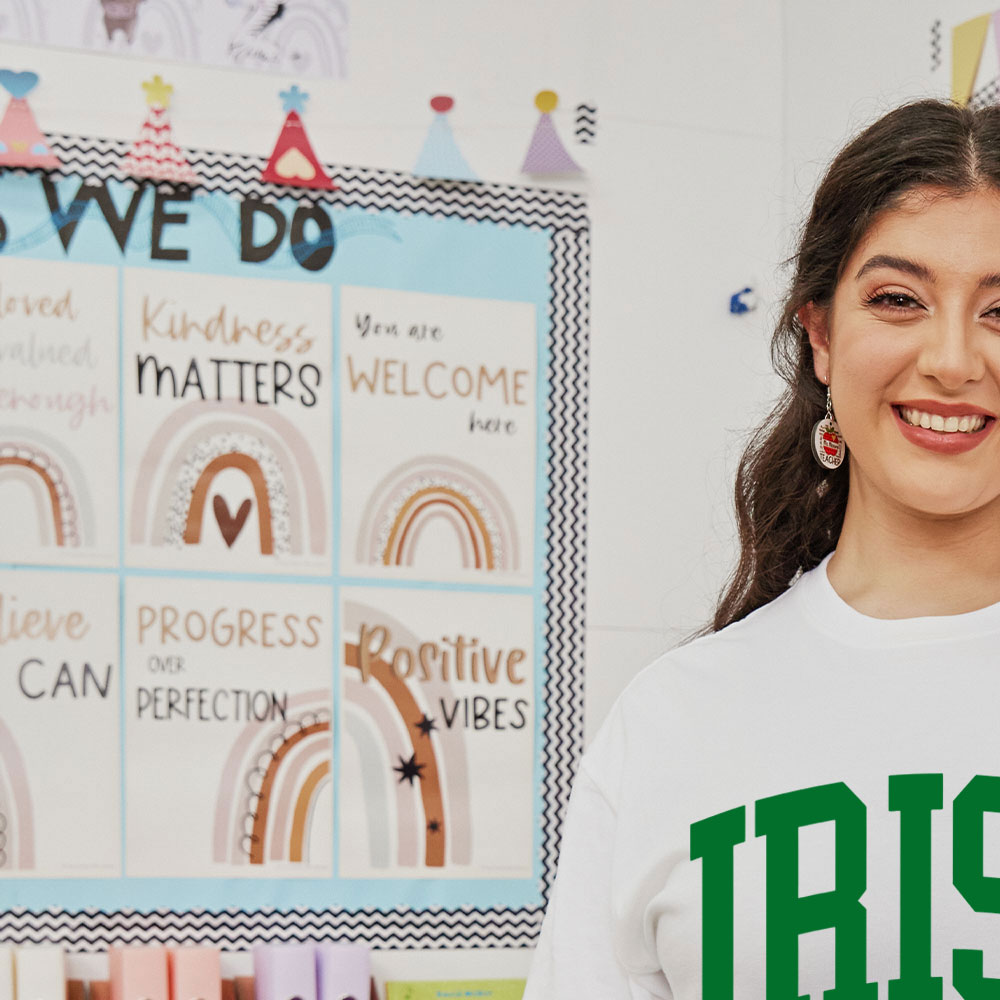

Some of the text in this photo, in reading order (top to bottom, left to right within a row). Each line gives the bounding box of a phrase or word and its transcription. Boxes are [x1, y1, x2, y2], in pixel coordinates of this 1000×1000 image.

[40, 174, 192, 262] WE
[240, 193, 335, 272] DO
[140, 294, 316, 355] Kindness
[355, 312, 443, 342] You are
[346, 354, 530, 407] WELCOME
[468, 410, 518, 435] here
[137, 604, 324, 650] PROGRESS
[147, 654, 186, 675] OVER
[356, 622, 527, 685] Positive
[18, 657, 113, 700] CAN
[136, 686, 289, 723] PERFECTION
[439, 695, 529, 732] VIBES
